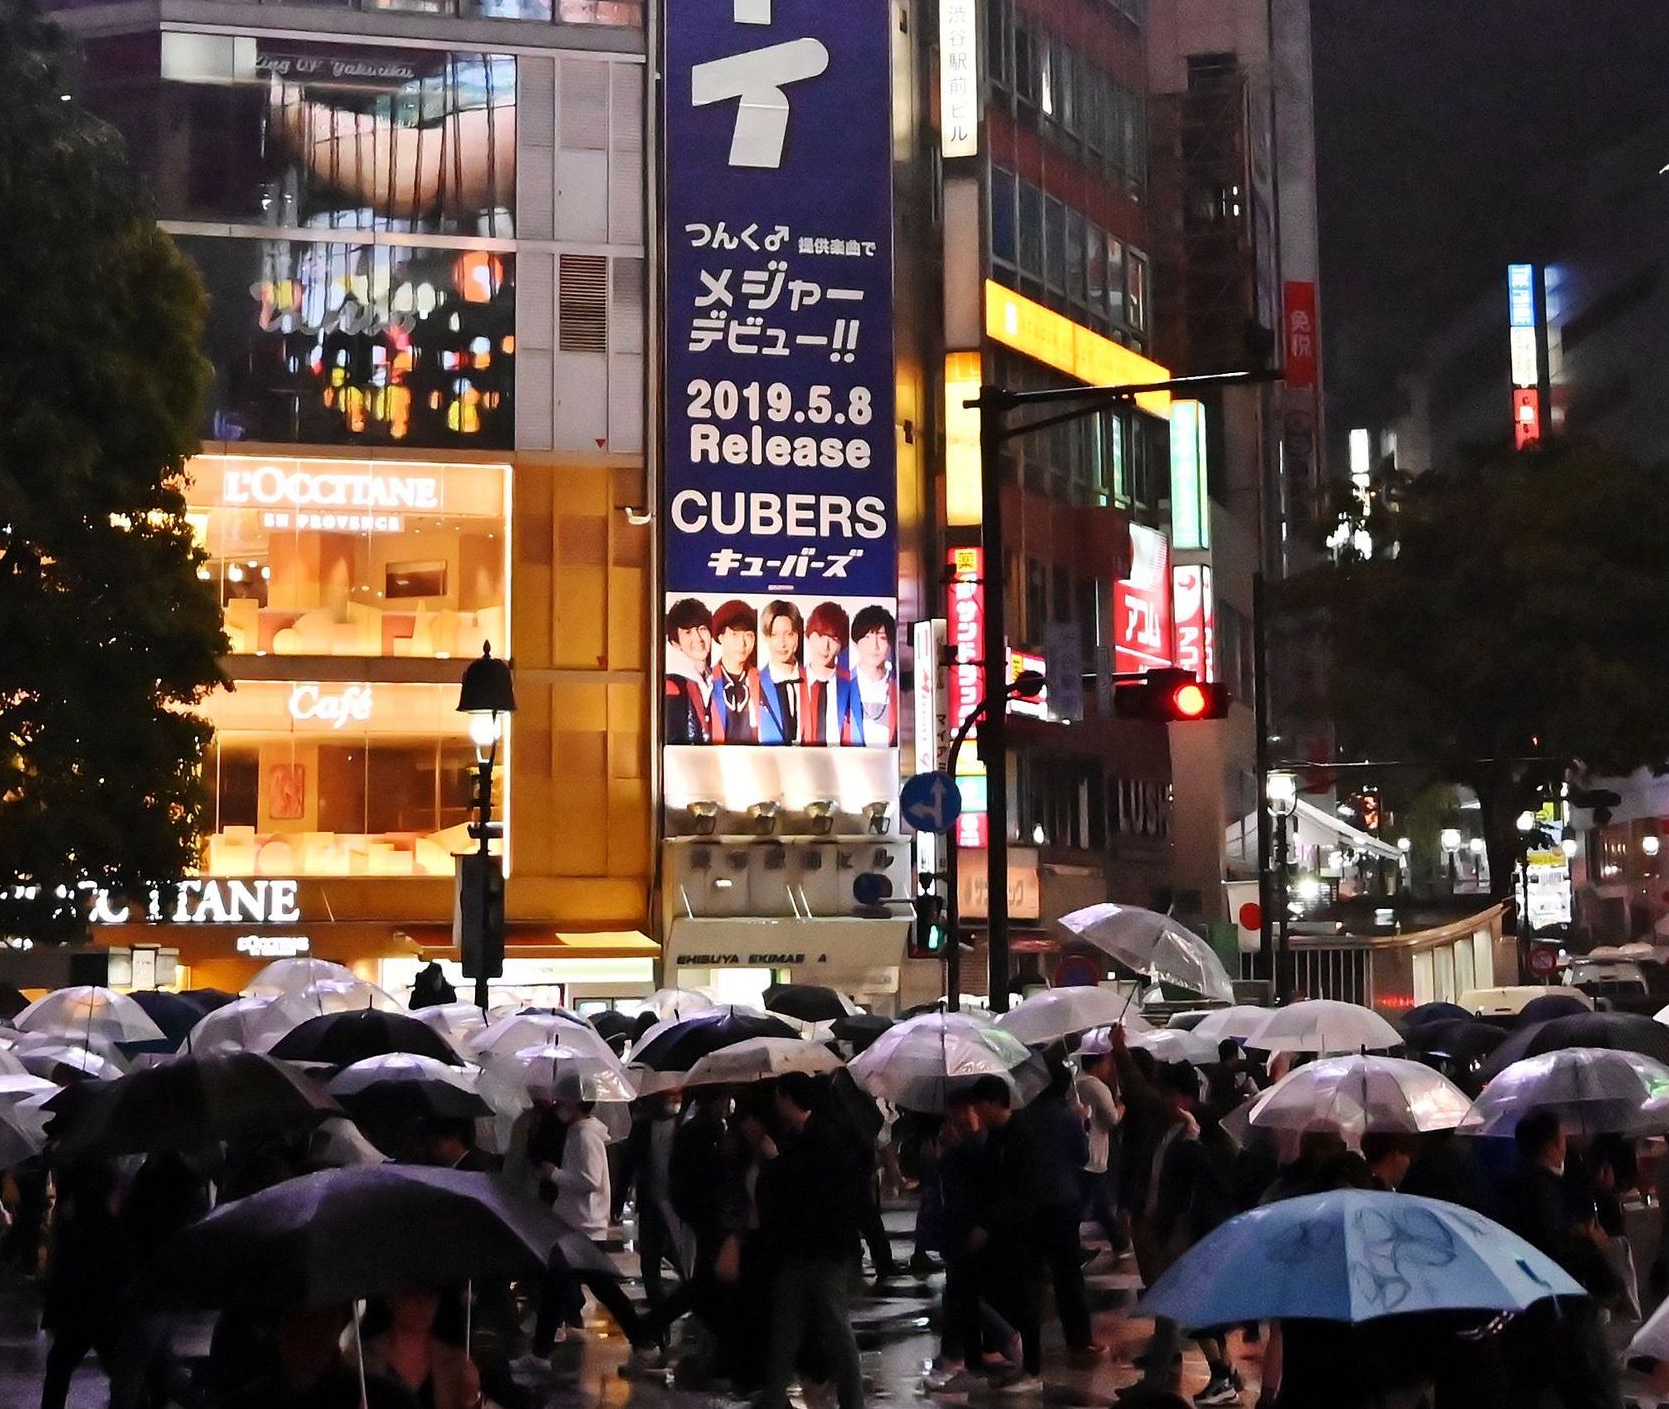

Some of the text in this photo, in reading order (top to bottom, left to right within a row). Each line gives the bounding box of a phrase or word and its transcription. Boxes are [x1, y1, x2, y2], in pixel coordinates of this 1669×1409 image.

[947, 5, 968, 143] 渋谷駅前ビル
[797, 236, 877, 257] 提供楽曲で
[694, 260, 865, 312] メジャー
[688, 309, 860, 363] デビュー!!
[686, 378, 874, 426] 2019.5.8
[690, 423, 872, 469] Release
[224, 466, 438, 509] L'OCCITANE
[297, 514, 401, 532] PROVENCE
[671, 489, 887, 539] CUBERS
[707, 547, 864, 579] キューバーズ
[1124, 594, 1162, 649] アコム
[288, 685, 373, 729] Café
